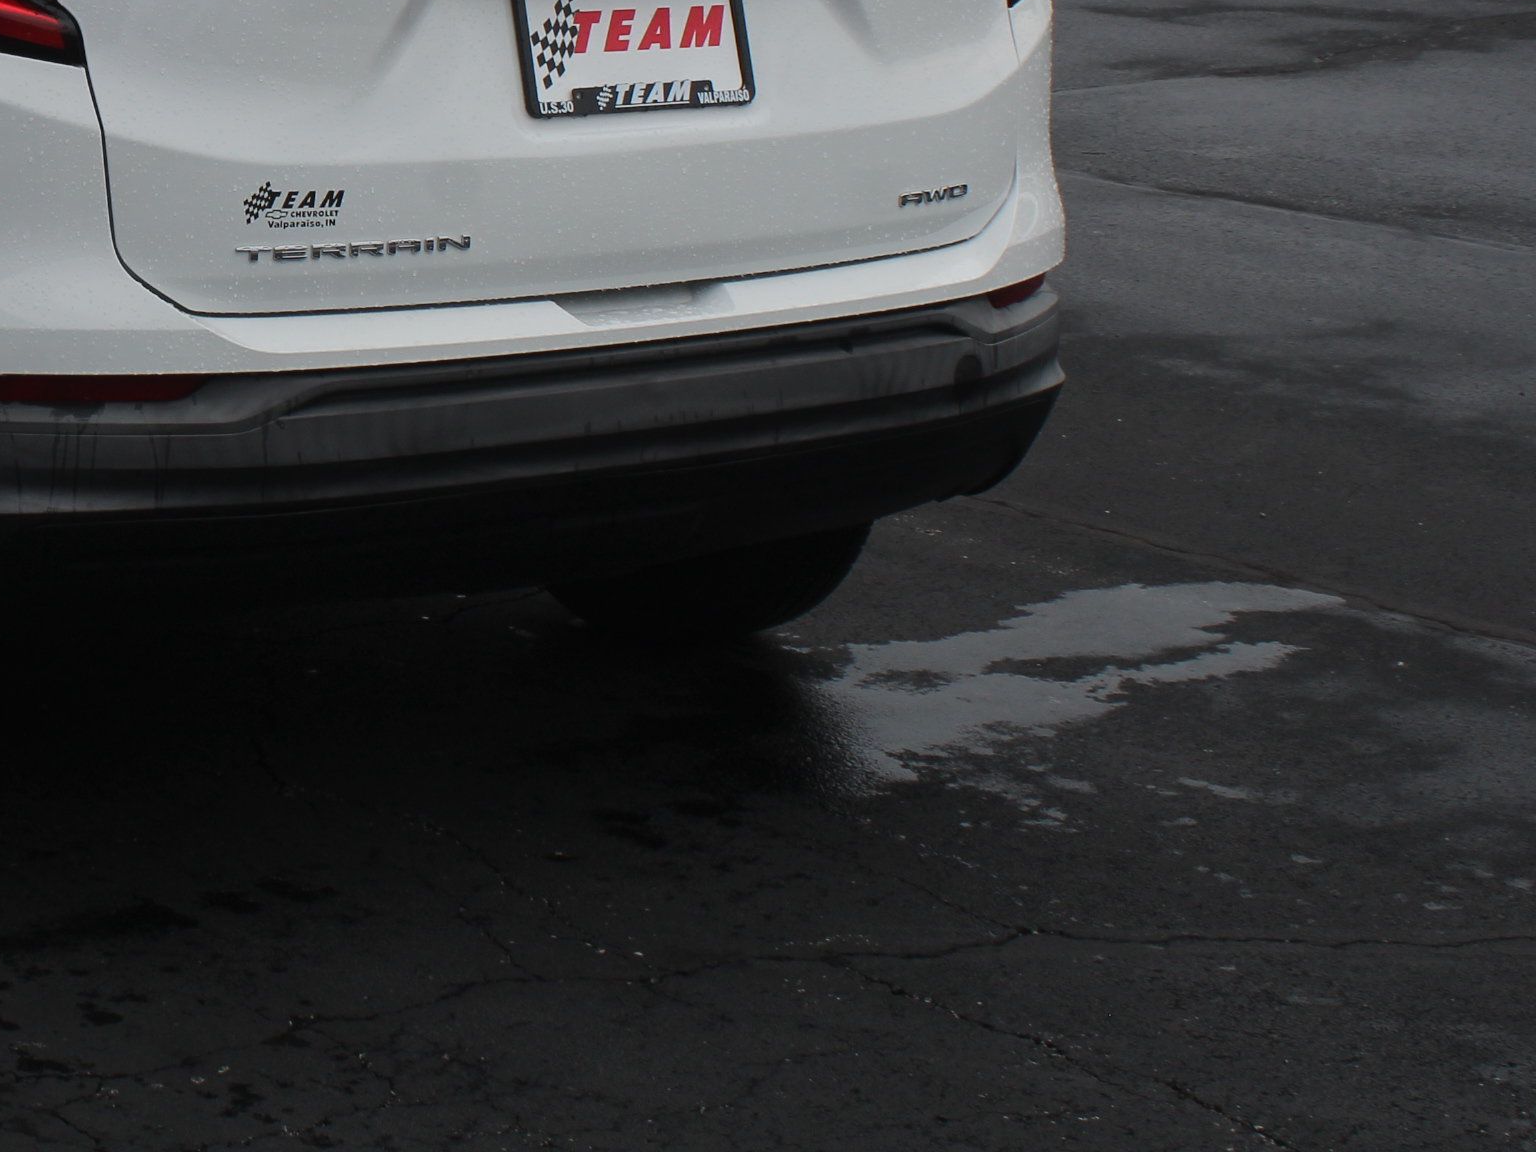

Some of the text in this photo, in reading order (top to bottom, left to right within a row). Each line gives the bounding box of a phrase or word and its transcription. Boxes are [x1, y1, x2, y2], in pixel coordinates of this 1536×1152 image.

[572, 4, 725, 54] TEAM
[614, 79, 692, 105] TEAM
[697, 88, 751, 104] VALPARAISO
[265, 189, 345, 209] TEAM
[898, 182, 968, 208] AWD
[267, 218, 336, 230] Valparaiso, IN
[290, 209, 339, 218] CHEVROLET
[234, 234, 471, 261] TERRAIN
